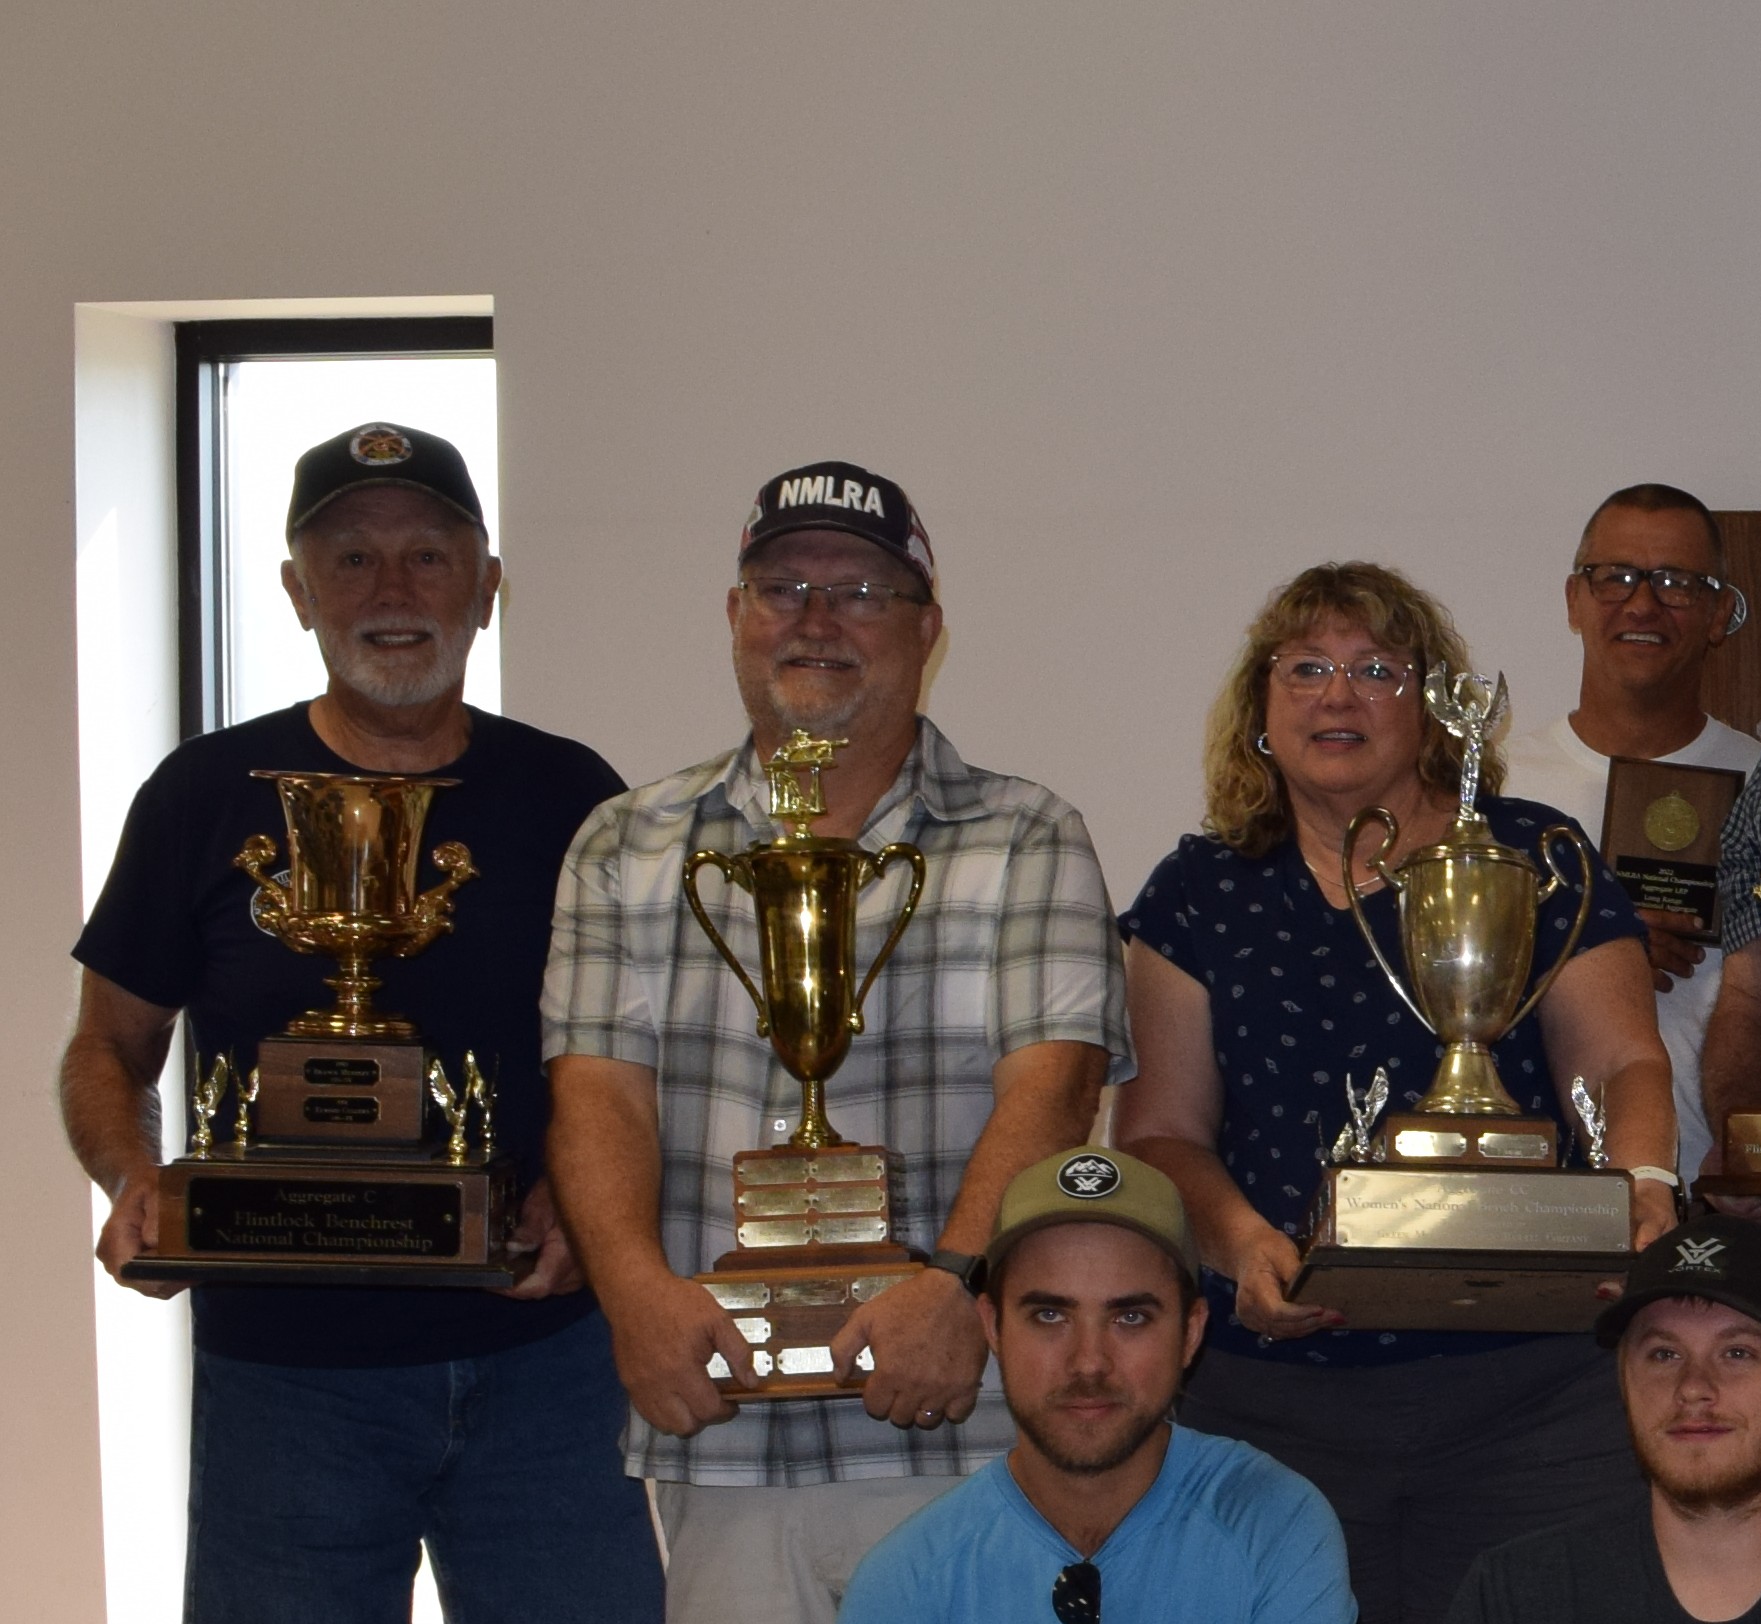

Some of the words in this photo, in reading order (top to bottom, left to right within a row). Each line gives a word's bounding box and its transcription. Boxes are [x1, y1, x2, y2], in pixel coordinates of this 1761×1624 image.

[778, 475, 885, 518] NMLRA
[274, 1189, 355, 1205] Aggregate
[1346, 1197, 1408, 1211] Women's
[1525, 1201, 1620, 1217] Championship
[234, 1210, 316, 1229] Flintlock
[325, 1213, 413, 1231] Benchrest
[214, 1227, 293, 1247] National
[302, 1230, 433, 1252] Championship
